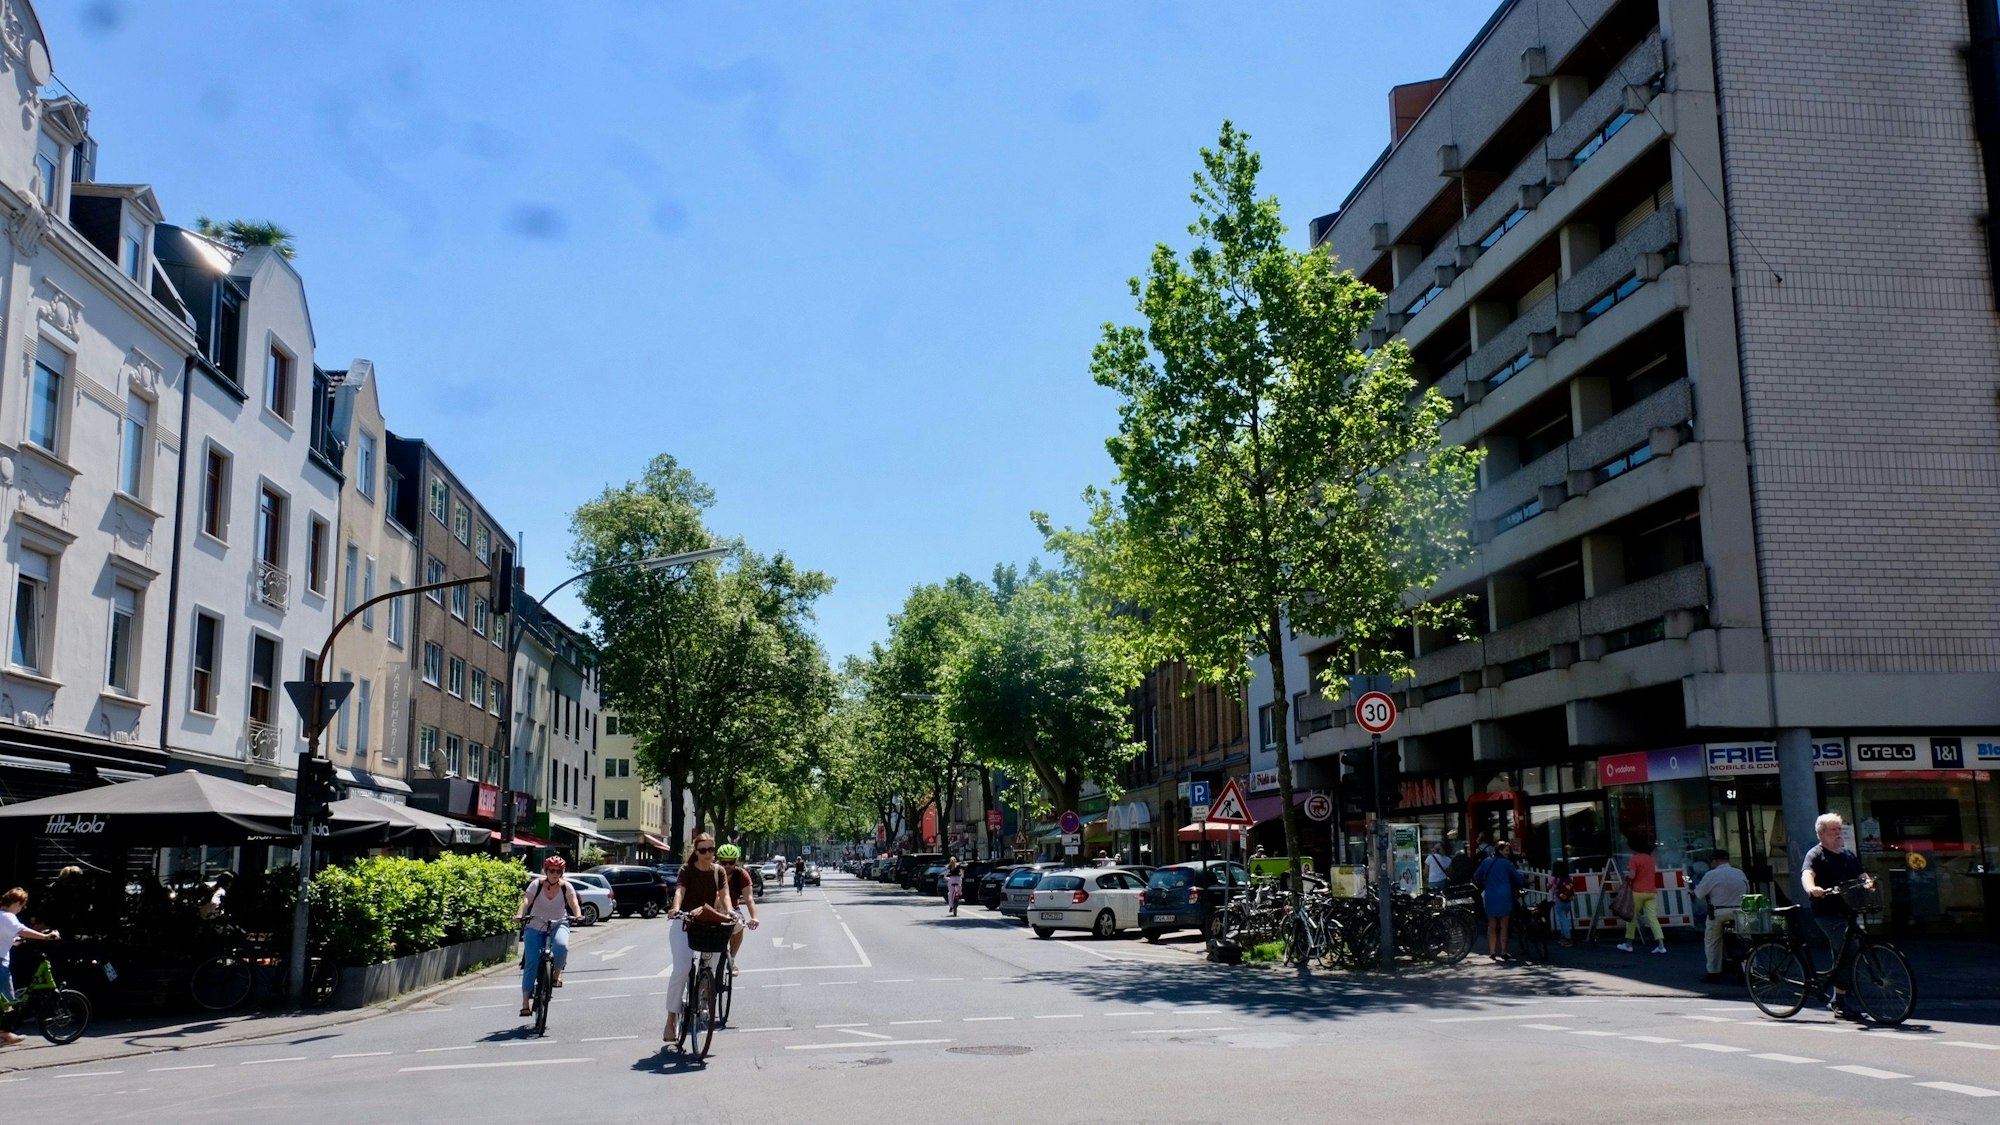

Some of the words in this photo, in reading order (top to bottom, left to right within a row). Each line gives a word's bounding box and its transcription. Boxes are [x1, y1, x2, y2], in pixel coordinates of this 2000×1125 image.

[1365, 703, 1387, 722] 30
[1935, 745, 1957, 761] 1&1
[1615, 765, 1636, 774] vodafone
[1710, 763, 1746, 771] MOBILE
[479, 787, 497, 812] REWE
[1195, 785, 1204, 802] P
[44, 814, 105, 834] fritz-kola
